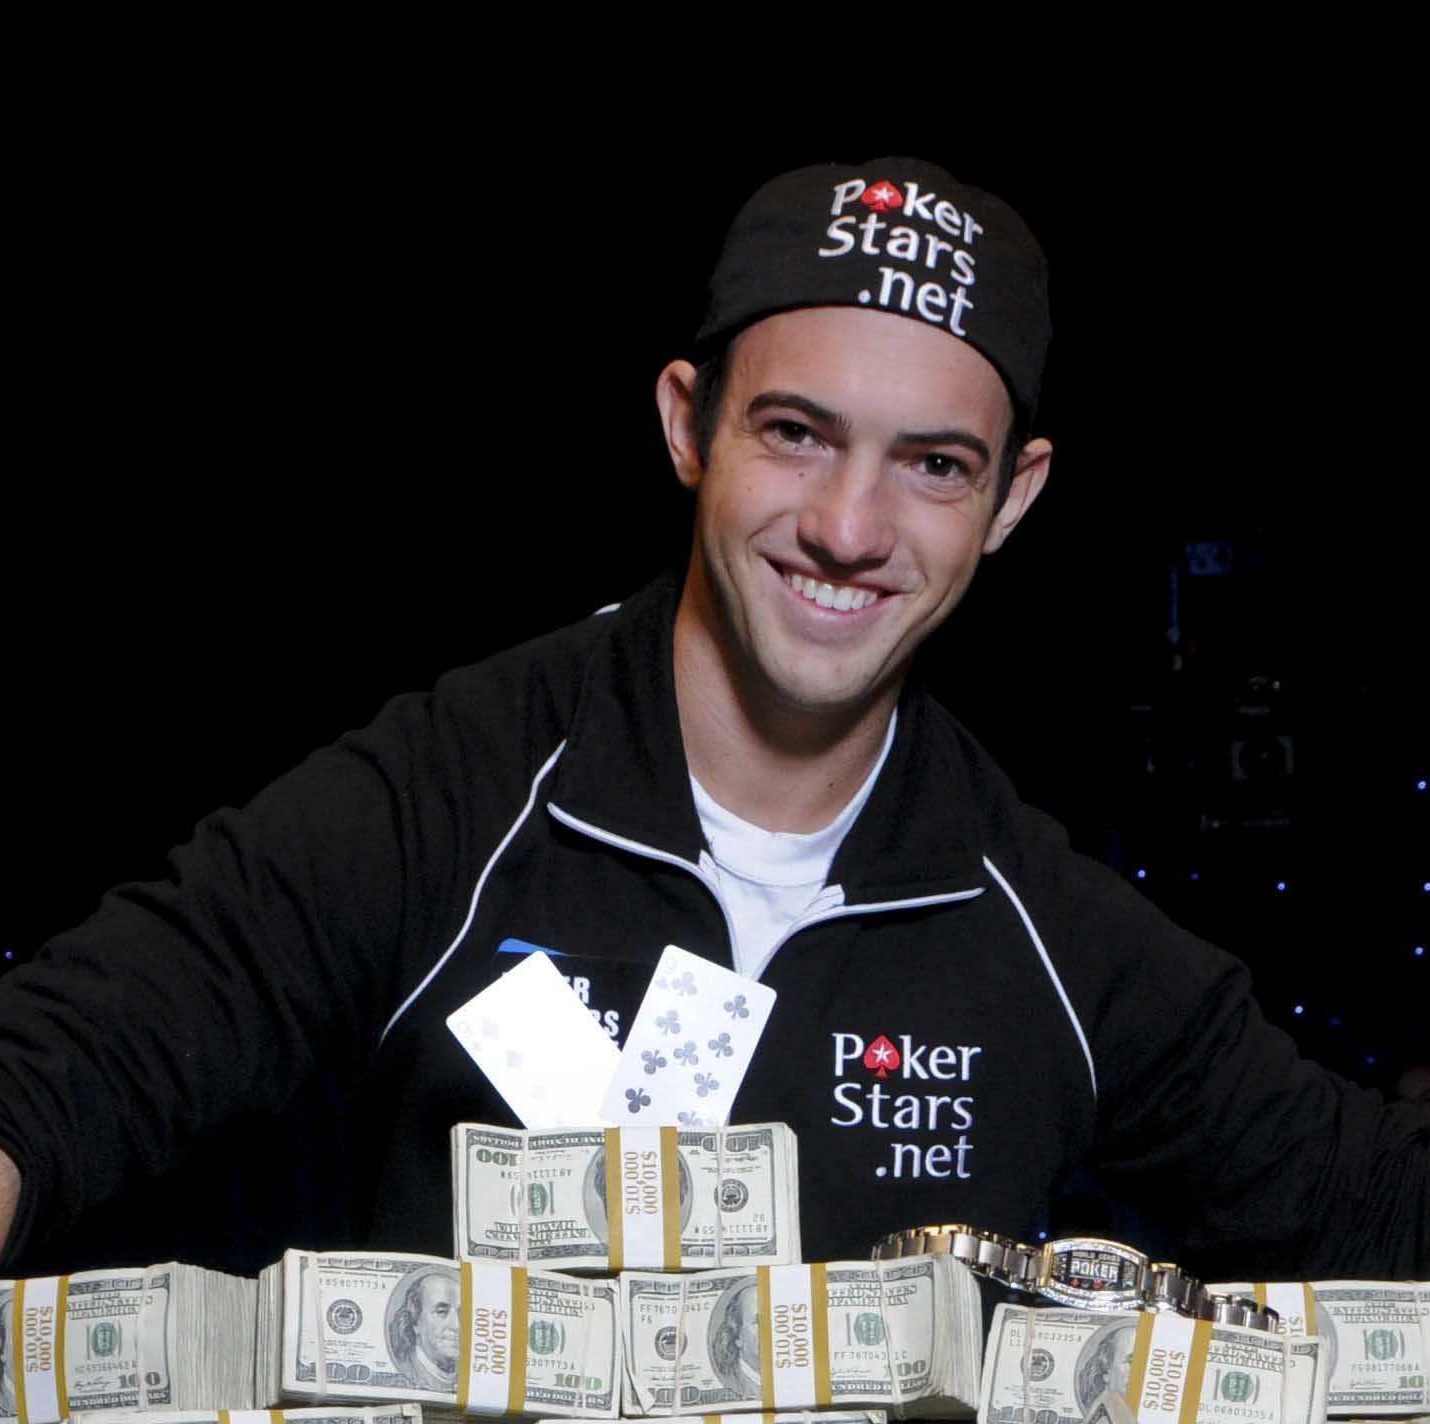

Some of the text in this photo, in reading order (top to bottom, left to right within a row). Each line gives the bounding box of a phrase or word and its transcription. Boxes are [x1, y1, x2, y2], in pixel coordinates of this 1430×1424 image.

[818, 215, 977, 287] Stars
[858, 266, 974, 336] .net
[831, 1083, 974, 1132] Stars
[624, 1151, 641, 1215] $10,000
[642, 1151, 658, 1215] $10,000
[874, 1134, 974, 1180] .net
[26, 1307, 39, 1372] $10,000
[40, 1306, 53, 1372] $10,000
[474, 1308, 490, 1373] $10,000
[491, 1310, 507, 1375] $10,000
[775, 1304, 792, 1369] $10,000
[792, 1303, 809, 1368] $10,000
[1143, 1348, 1167, 1411] $10,000
[1162, 1350, 1186, 1411] $10,000
